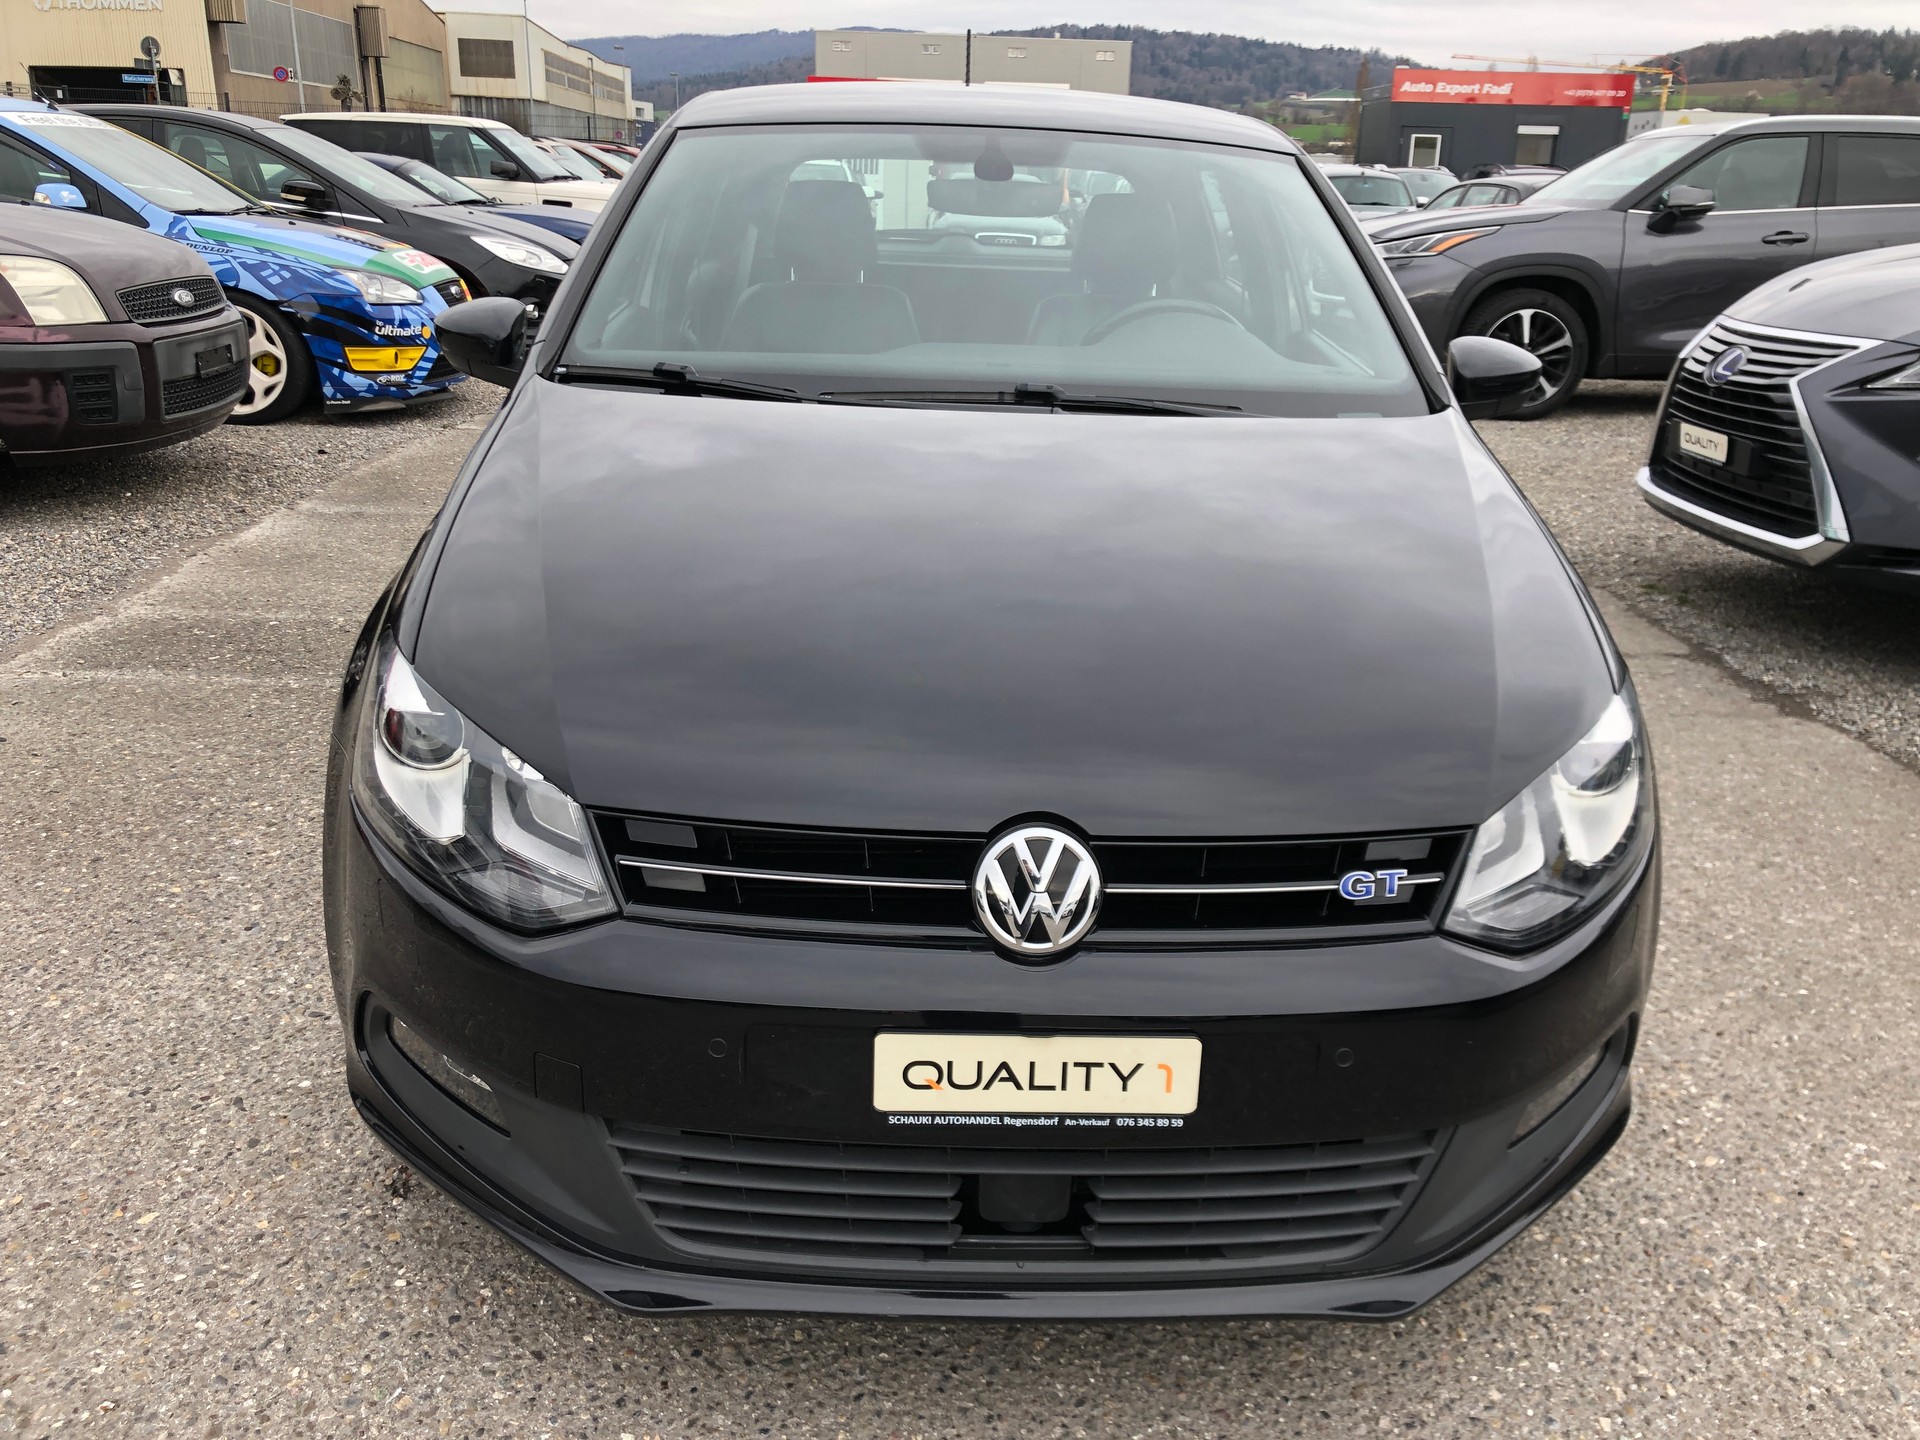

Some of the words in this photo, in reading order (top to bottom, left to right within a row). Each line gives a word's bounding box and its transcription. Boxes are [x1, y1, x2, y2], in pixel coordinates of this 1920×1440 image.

[1400, 81, 1432, 93] Auto
[1435, 82, 1481, 97] Export
[185, 242, 234, 254] DUNLOP
[375, 324, 422, 337] ultimate
[1684, 432, 1720, 453] QUALITY
[1339, 869, 1408, 900] GT
[902, 1060, 1145, 1092] QUALITY
[1157, 1063, 1173, 1093] 1
[888, 1115, 932, 1125] SCHAUKI
[934, 1115, 1002, 1125] AUTOHANDEL
[1003, 1116, 1060, 1127] Regensdorf
[1064, 1117, 1111, 1127] An-Verkauf
[1116, 1117, 1136, 1127] 076
[1136, 1117, 1155, 1127] 345
[1156, 1117, 1170, 1127] 89
[1170, 1118, 1184, 1128] 59
